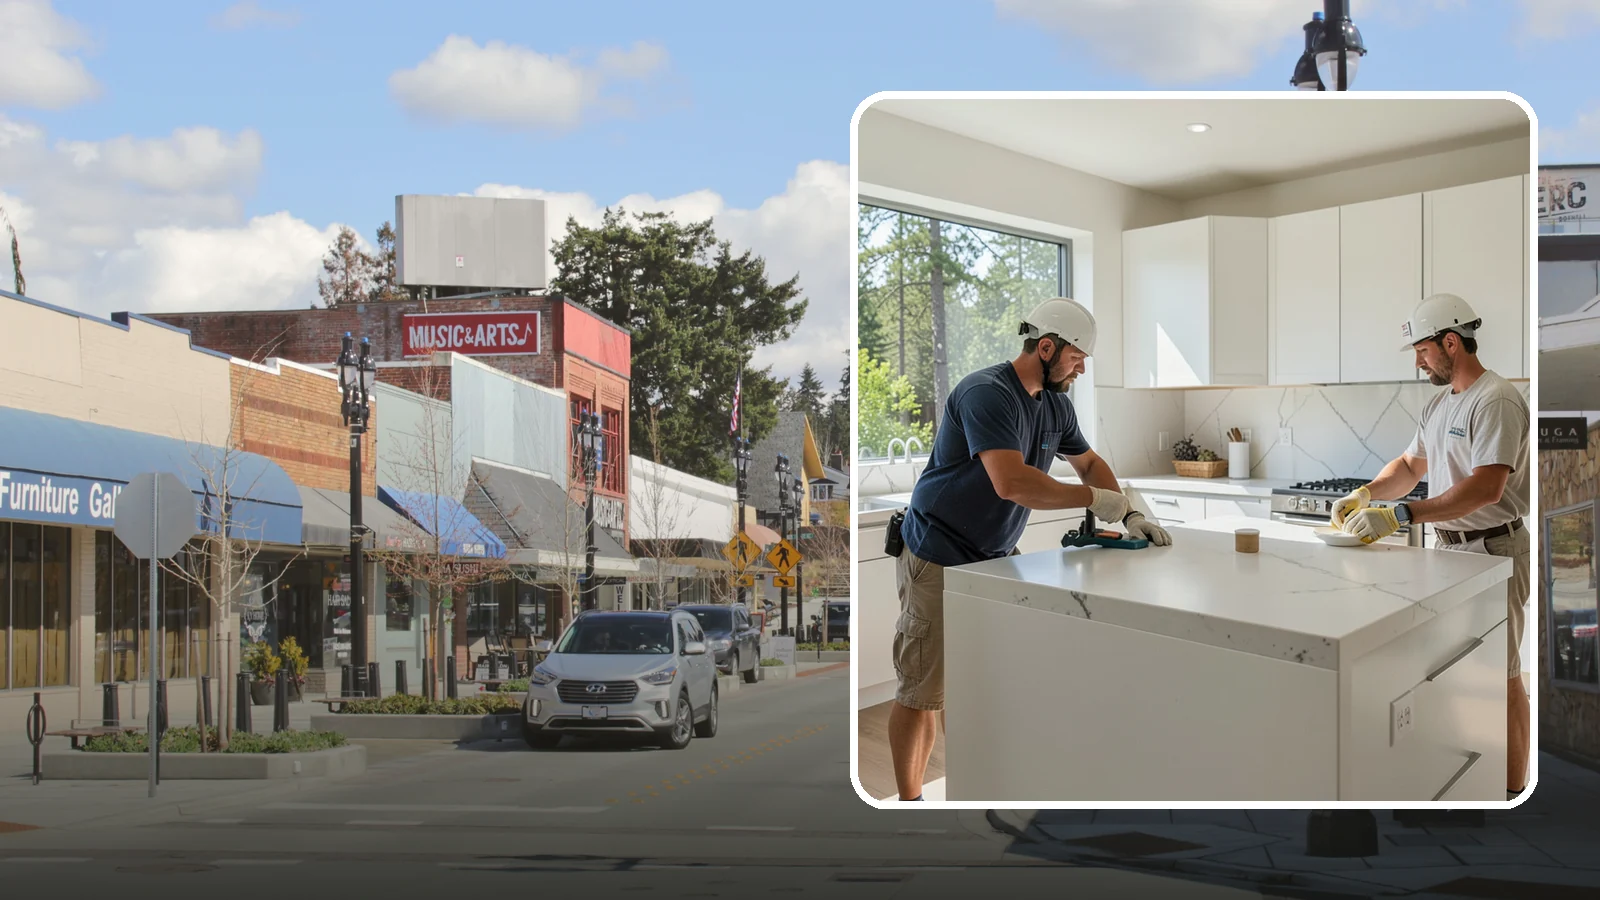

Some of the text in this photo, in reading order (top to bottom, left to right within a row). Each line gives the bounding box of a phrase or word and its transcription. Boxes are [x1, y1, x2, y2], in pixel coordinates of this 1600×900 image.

[409, 323, 519, 349] MUSIC&ARTS
[1540, 427, 1577, 437] UGA
[0, 472, 122, 519] Furniture Gal
[453, 562, 479, 574] SUSHI
